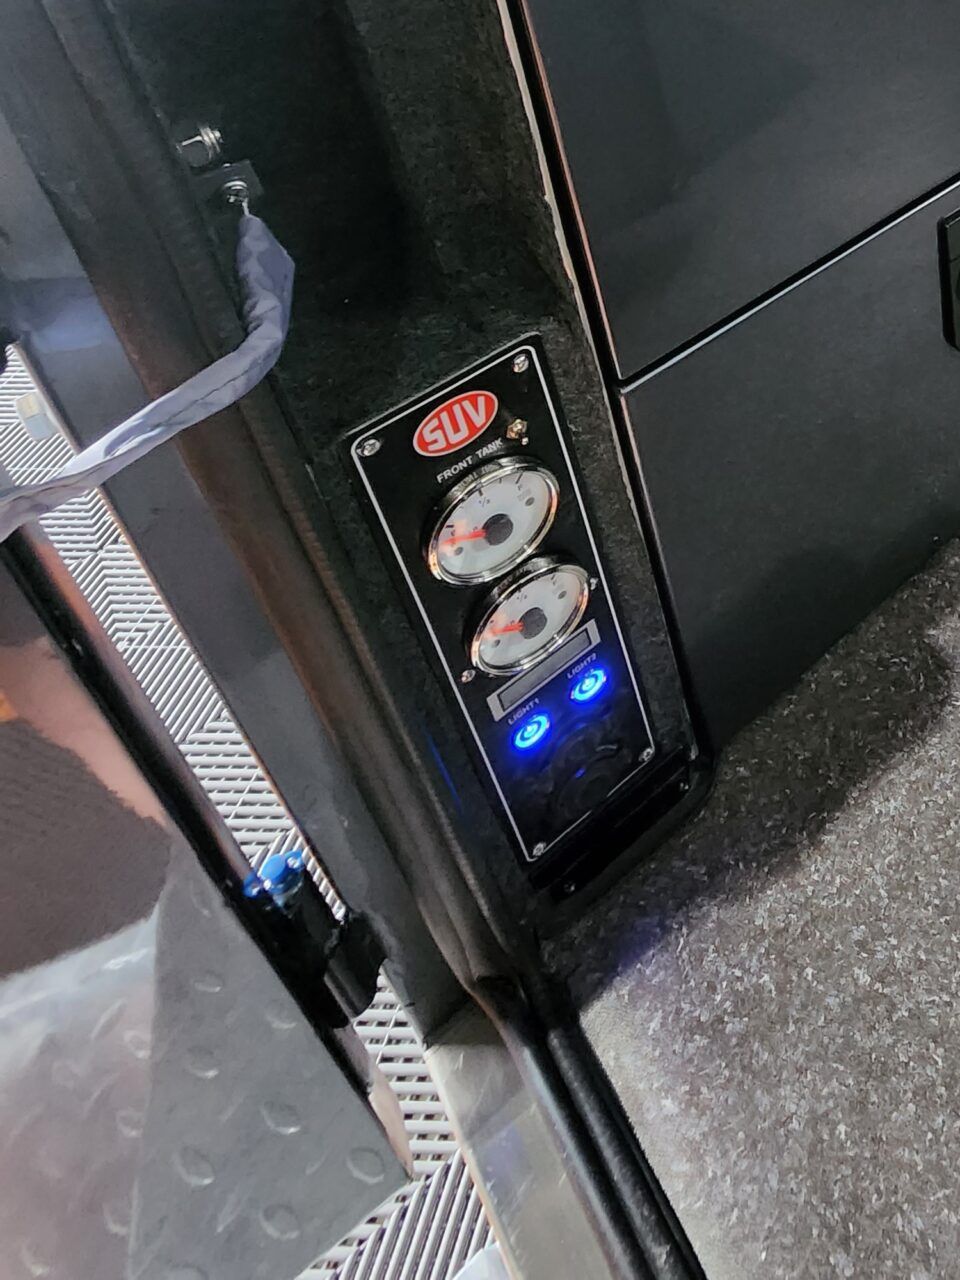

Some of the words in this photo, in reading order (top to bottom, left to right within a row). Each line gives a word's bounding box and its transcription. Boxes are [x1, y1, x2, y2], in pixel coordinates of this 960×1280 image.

[421, 395, 488, 452] SUV
[436, 456, 473, 483] FRONT
[475, 437, 503, 459] TANK
[566, 652, 597, 679] LIGHT2
[508, 698, 540, 725] LIGHT1
